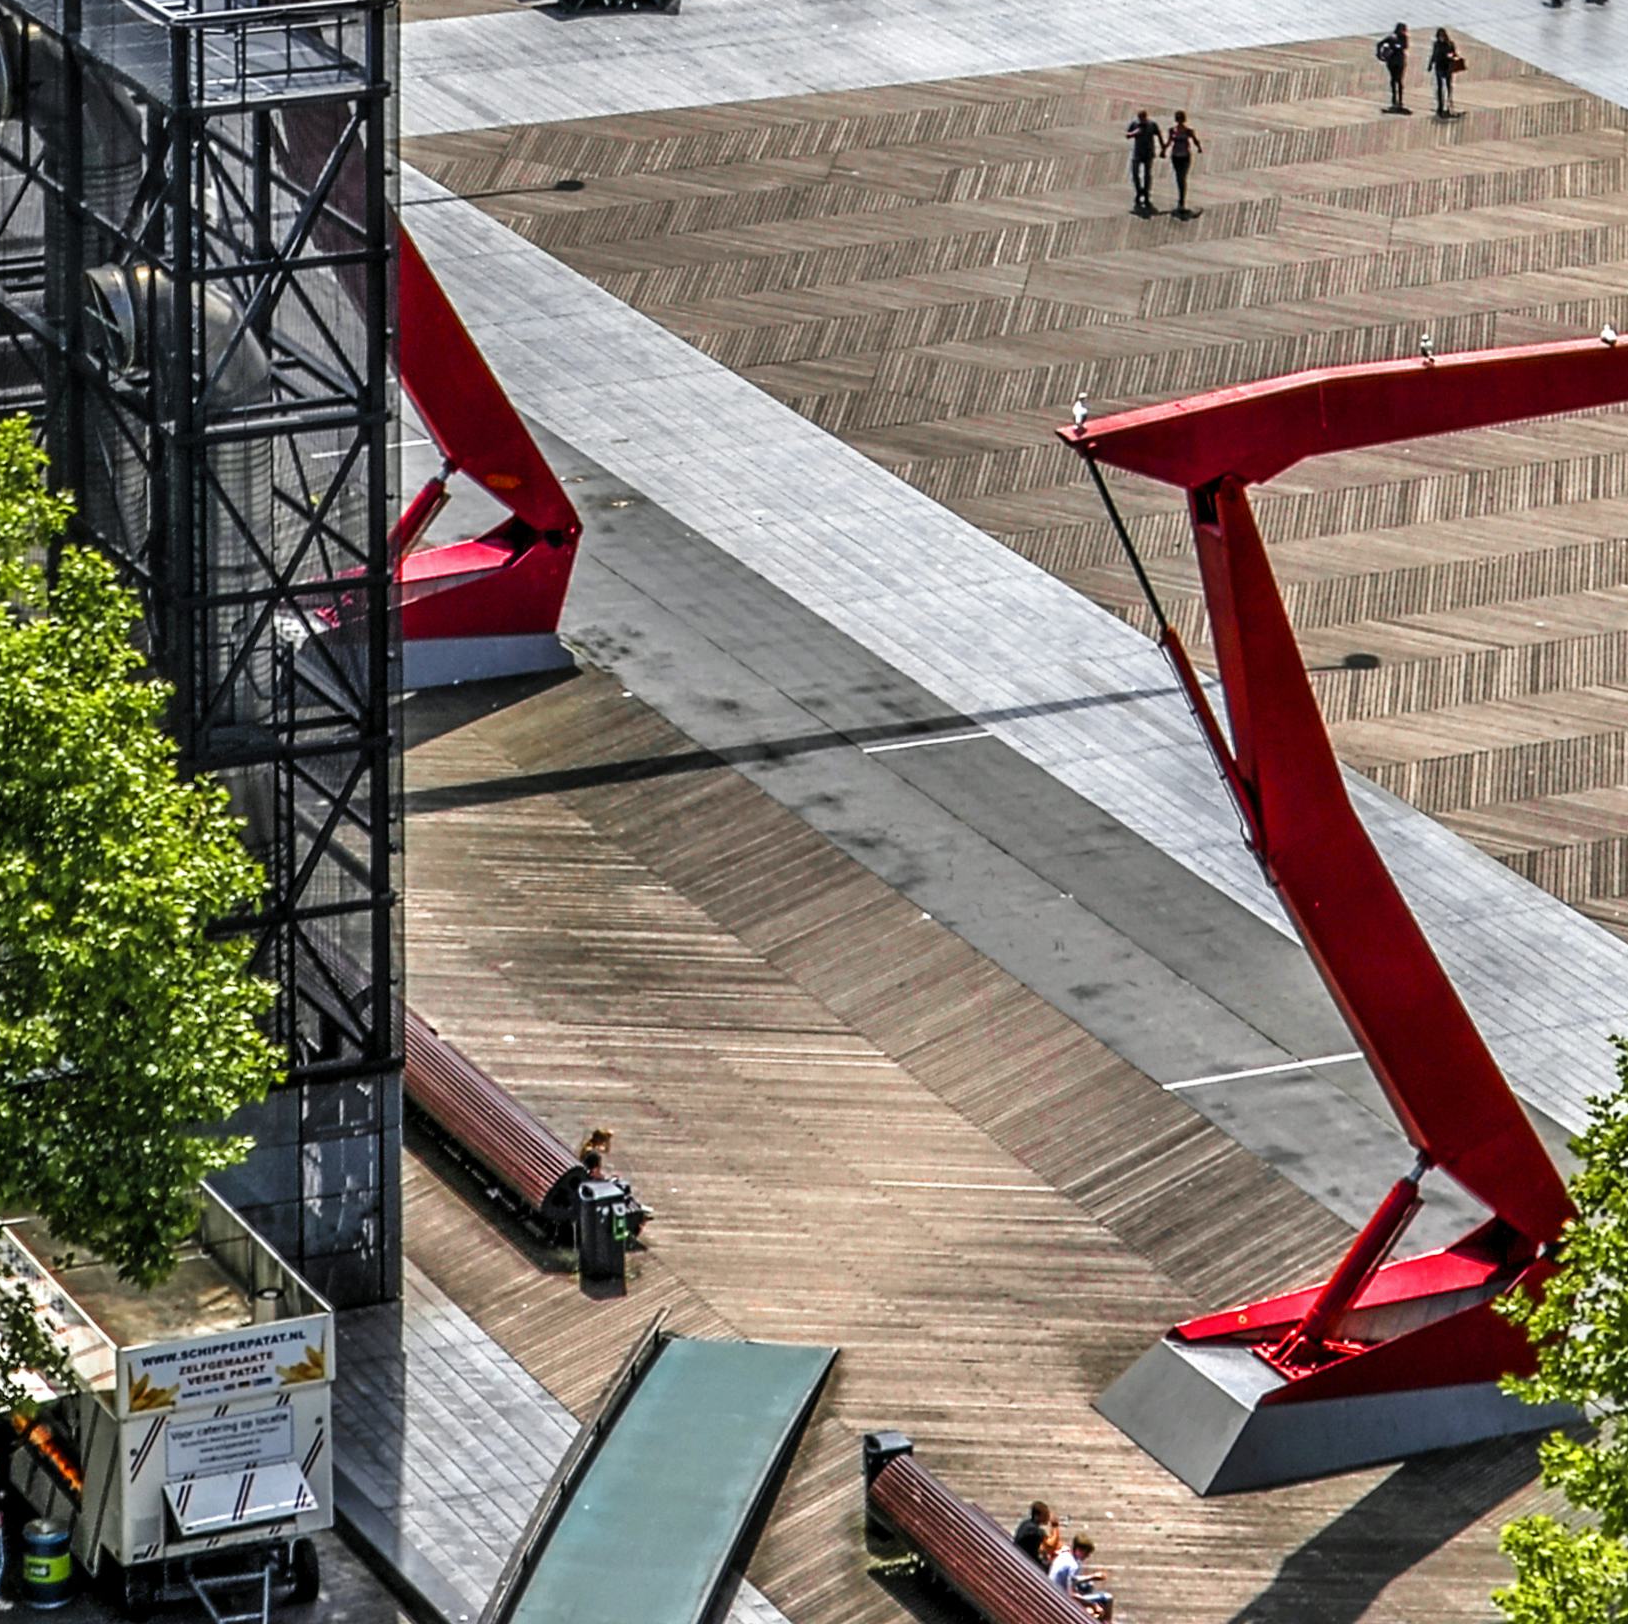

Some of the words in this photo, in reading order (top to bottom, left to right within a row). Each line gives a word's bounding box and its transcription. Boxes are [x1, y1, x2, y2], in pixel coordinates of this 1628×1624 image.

[141, 1331, 306, 1367] WWW.SCHIPPERPATAT.NL
[179, 1351, 274, 1376] ZELFGEMAAKTE
[187, 1373, 226, 1386] VERSE
[230, 1365, 266, 1379] PATAT
[171, 1430, 193, 1441] Voor
[197, 1423, 238, 1436] catering
[256, 1413, 289, 1426] locatie
